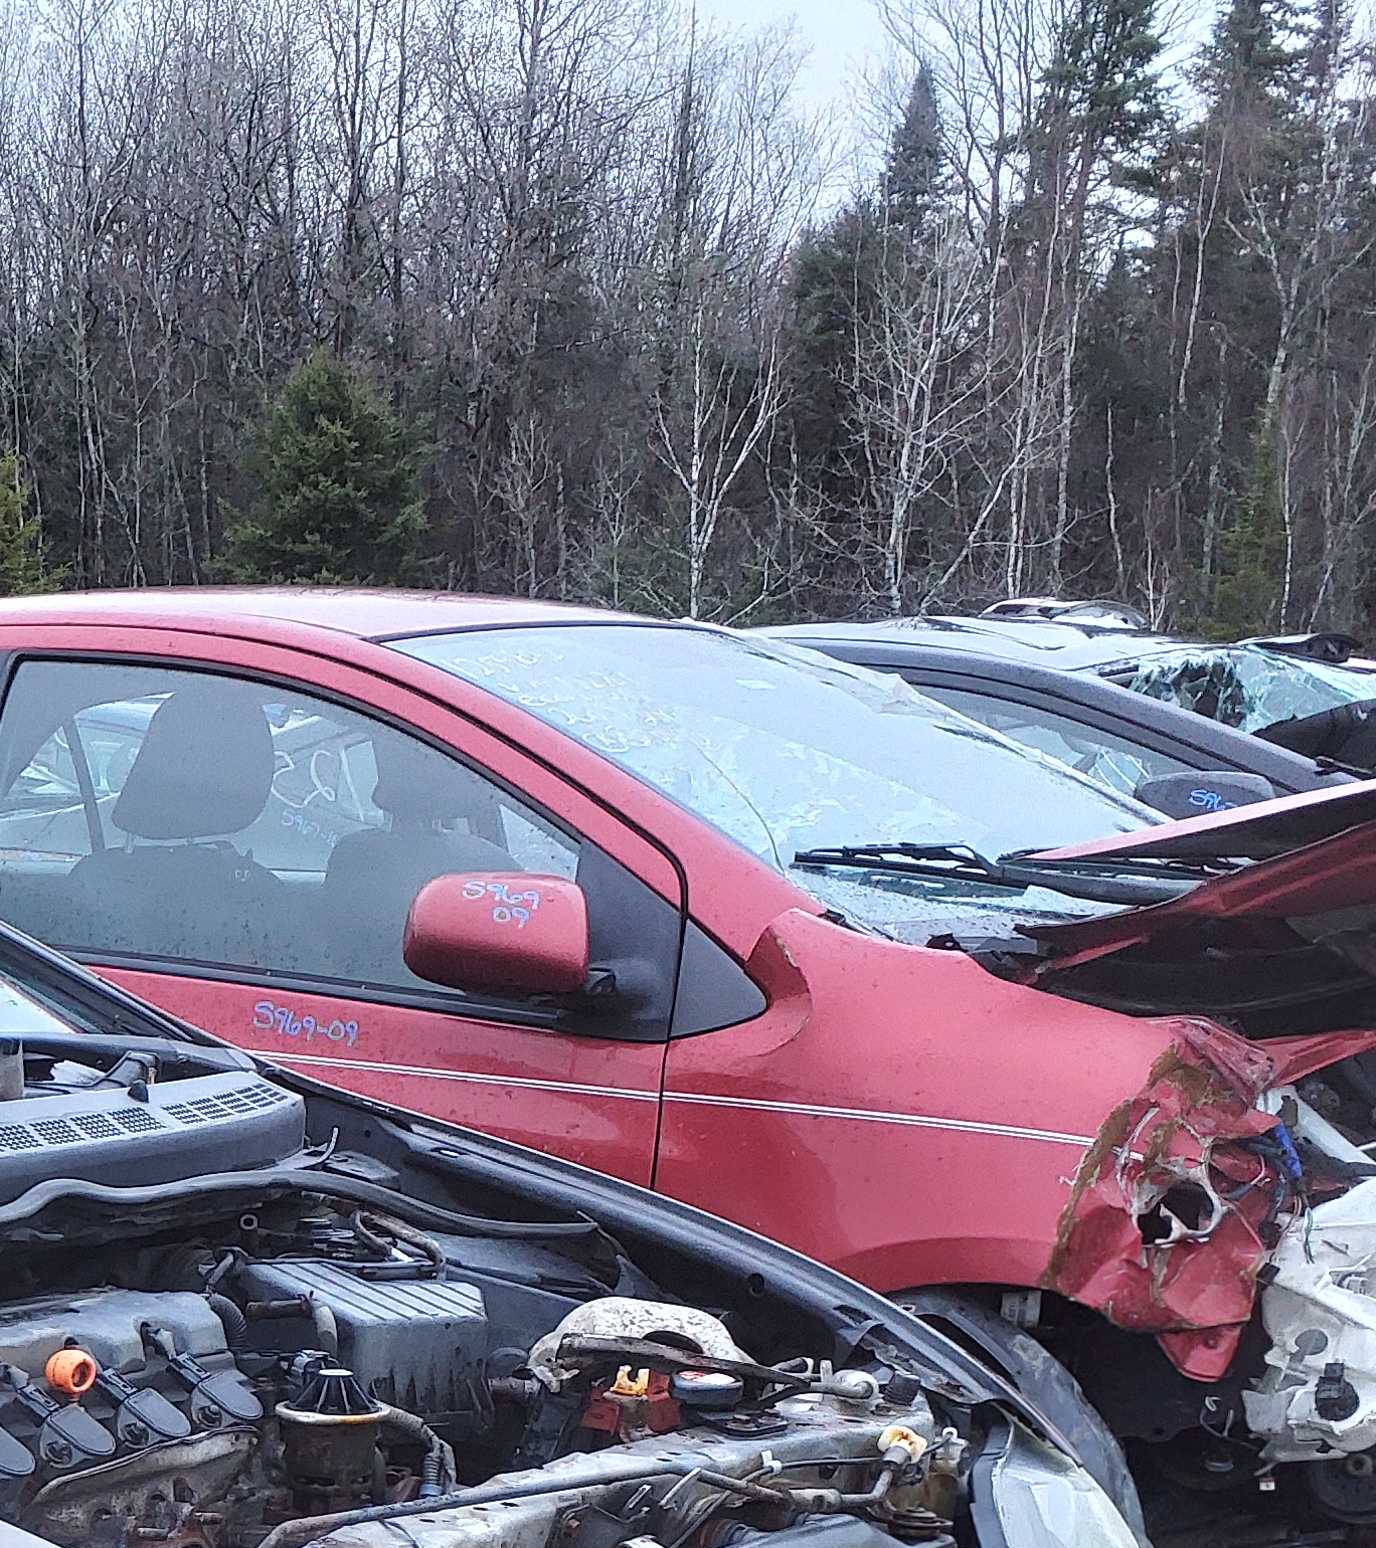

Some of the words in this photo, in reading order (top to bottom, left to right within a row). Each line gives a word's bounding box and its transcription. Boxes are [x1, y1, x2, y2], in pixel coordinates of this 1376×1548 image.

[462, 880, 540, 910] S969
[493, 906, 530, 928] 09
[253, 1000, 359, 1047] S969-09
